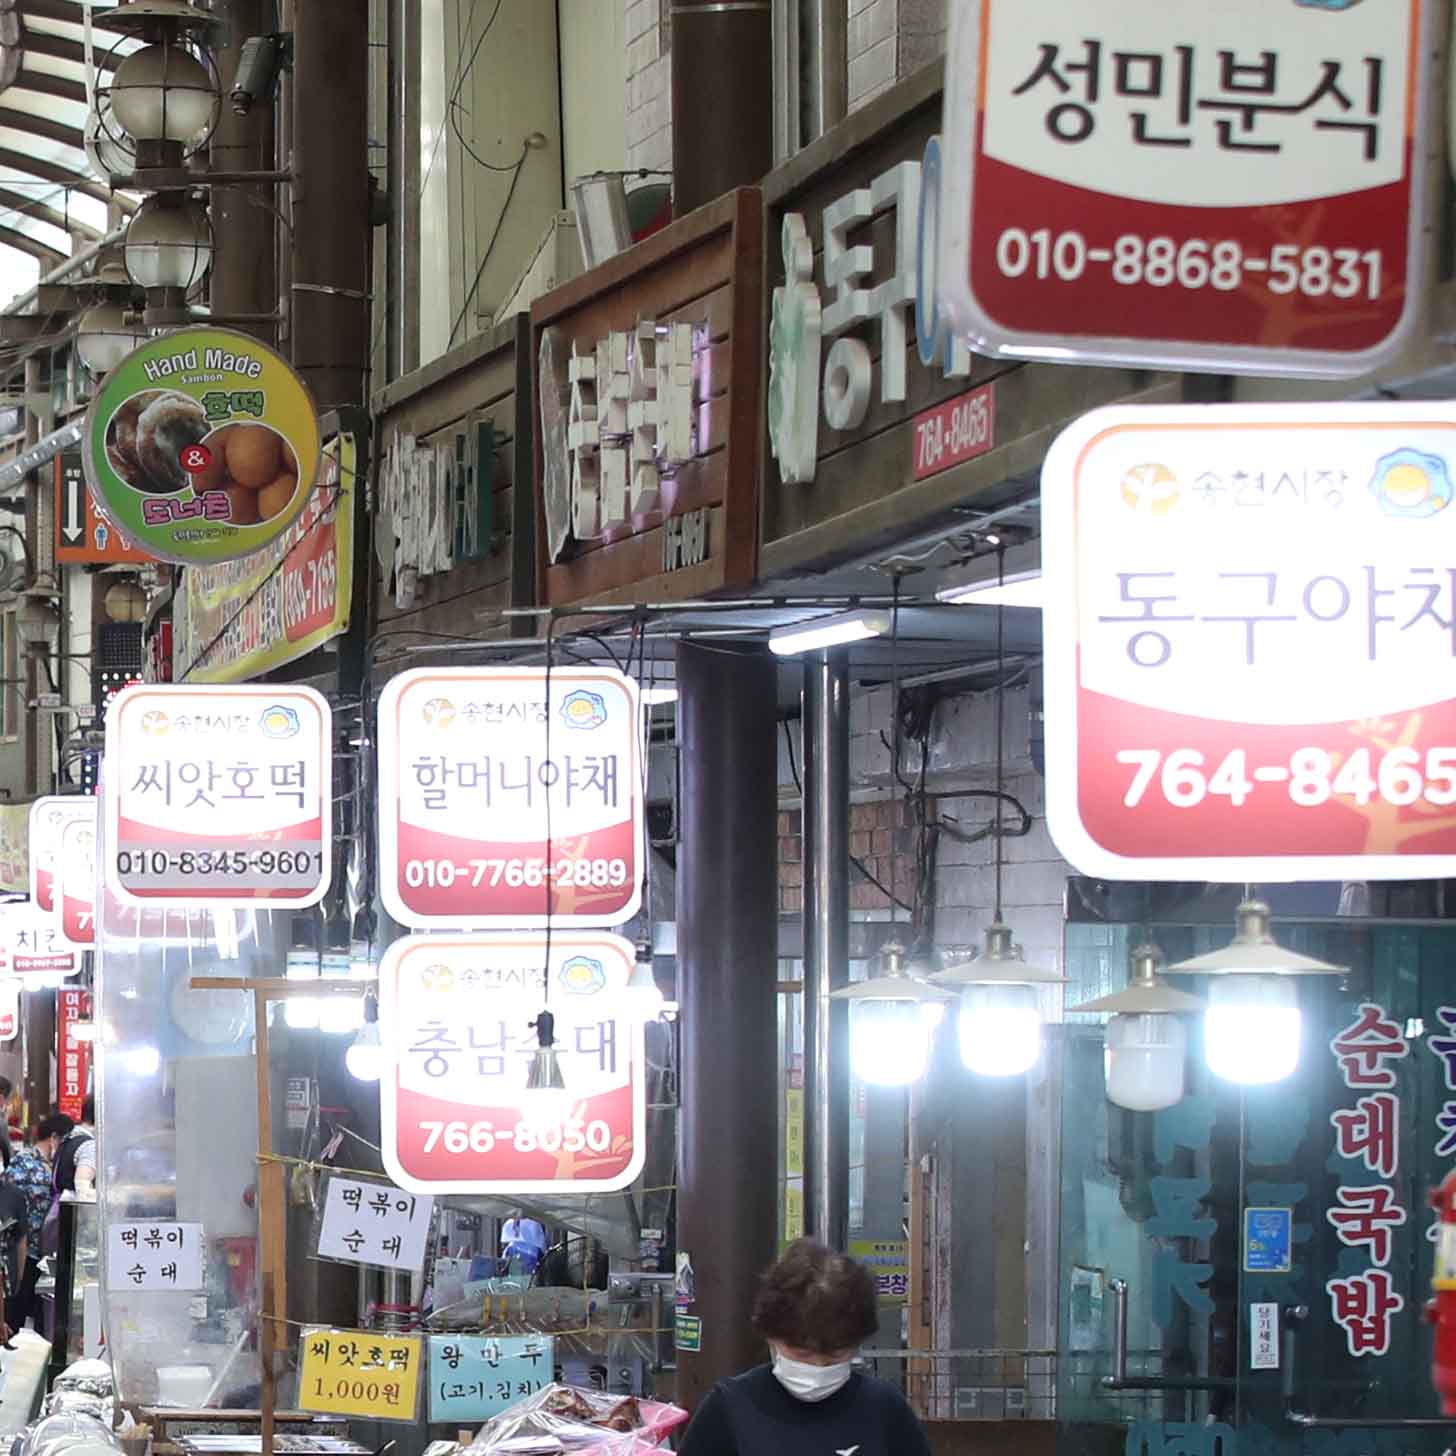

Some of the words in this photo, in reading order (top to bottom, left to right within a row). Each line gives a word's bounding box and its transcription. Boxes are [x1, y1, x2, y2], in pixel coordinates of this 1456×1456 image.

[1012, 40, 1383, 161] 성민분식
[997, 229, 1382, 299] 010-8868-5831
[144, 350, 198, 381] Hand
[204, 348, 262, 378] Made
[917, 402, 988, 472] 764-8465
[130, 758, 307, 810] 씨앗호떡
[411, 754, 620, 811] 할머니야채
[115, 850, 323, 876] 010-8345-9601
[405, 858, 626, 888] 010-7766-2889
[407, 1018, 619, 1078] 충남대
[418, 1119, 611, 1153] 766-8050
[1331, 1003, 1410, 1357] 순대국밥
[342, 1188, 417, 1222] 떡볶이
[119, 1227, 185, 1250] 떡볶이
[313, 1378, 402, 1406] 1,000원
